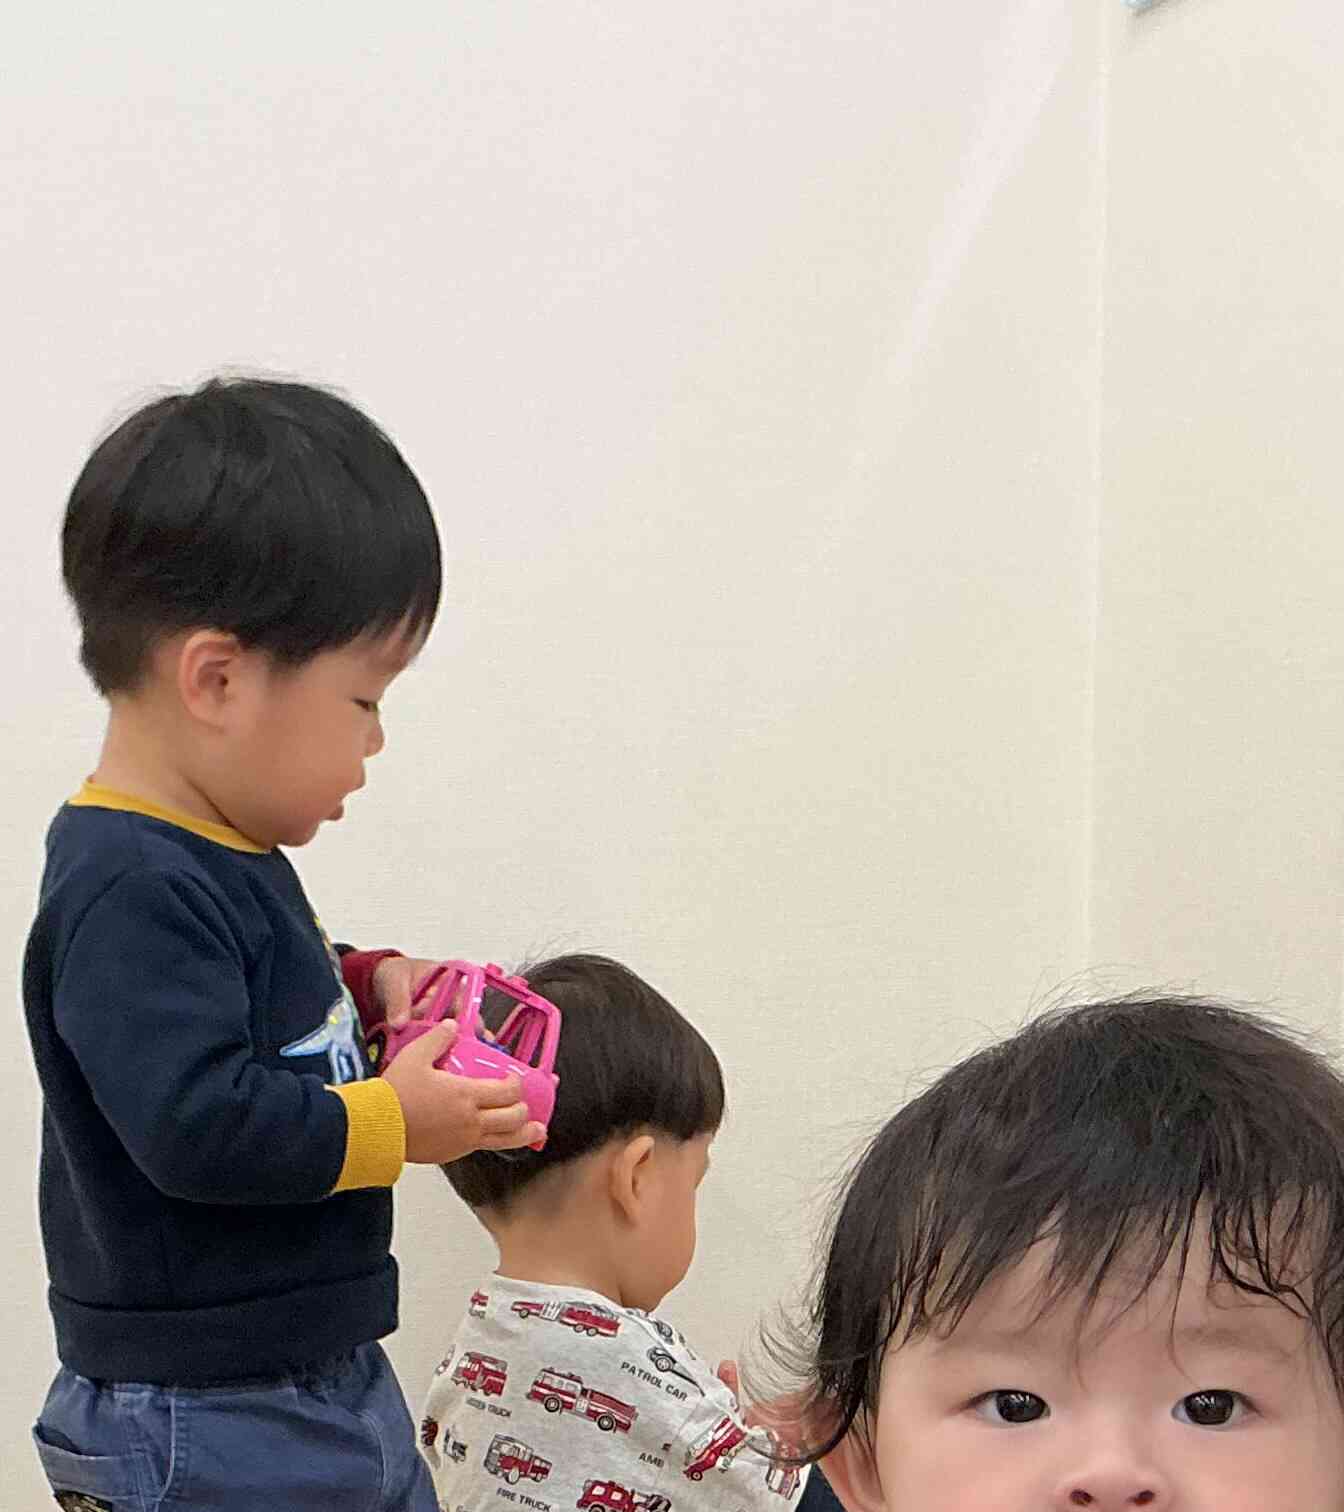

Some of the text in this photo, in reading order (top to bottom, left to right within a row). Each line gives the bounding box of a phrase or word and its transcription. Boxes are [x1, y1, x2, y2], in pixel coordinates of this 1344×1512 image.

[621, 1361, 688, 1402] PATROL CAR
[496, 1487, 551, 1512] FIRE TRUCK
